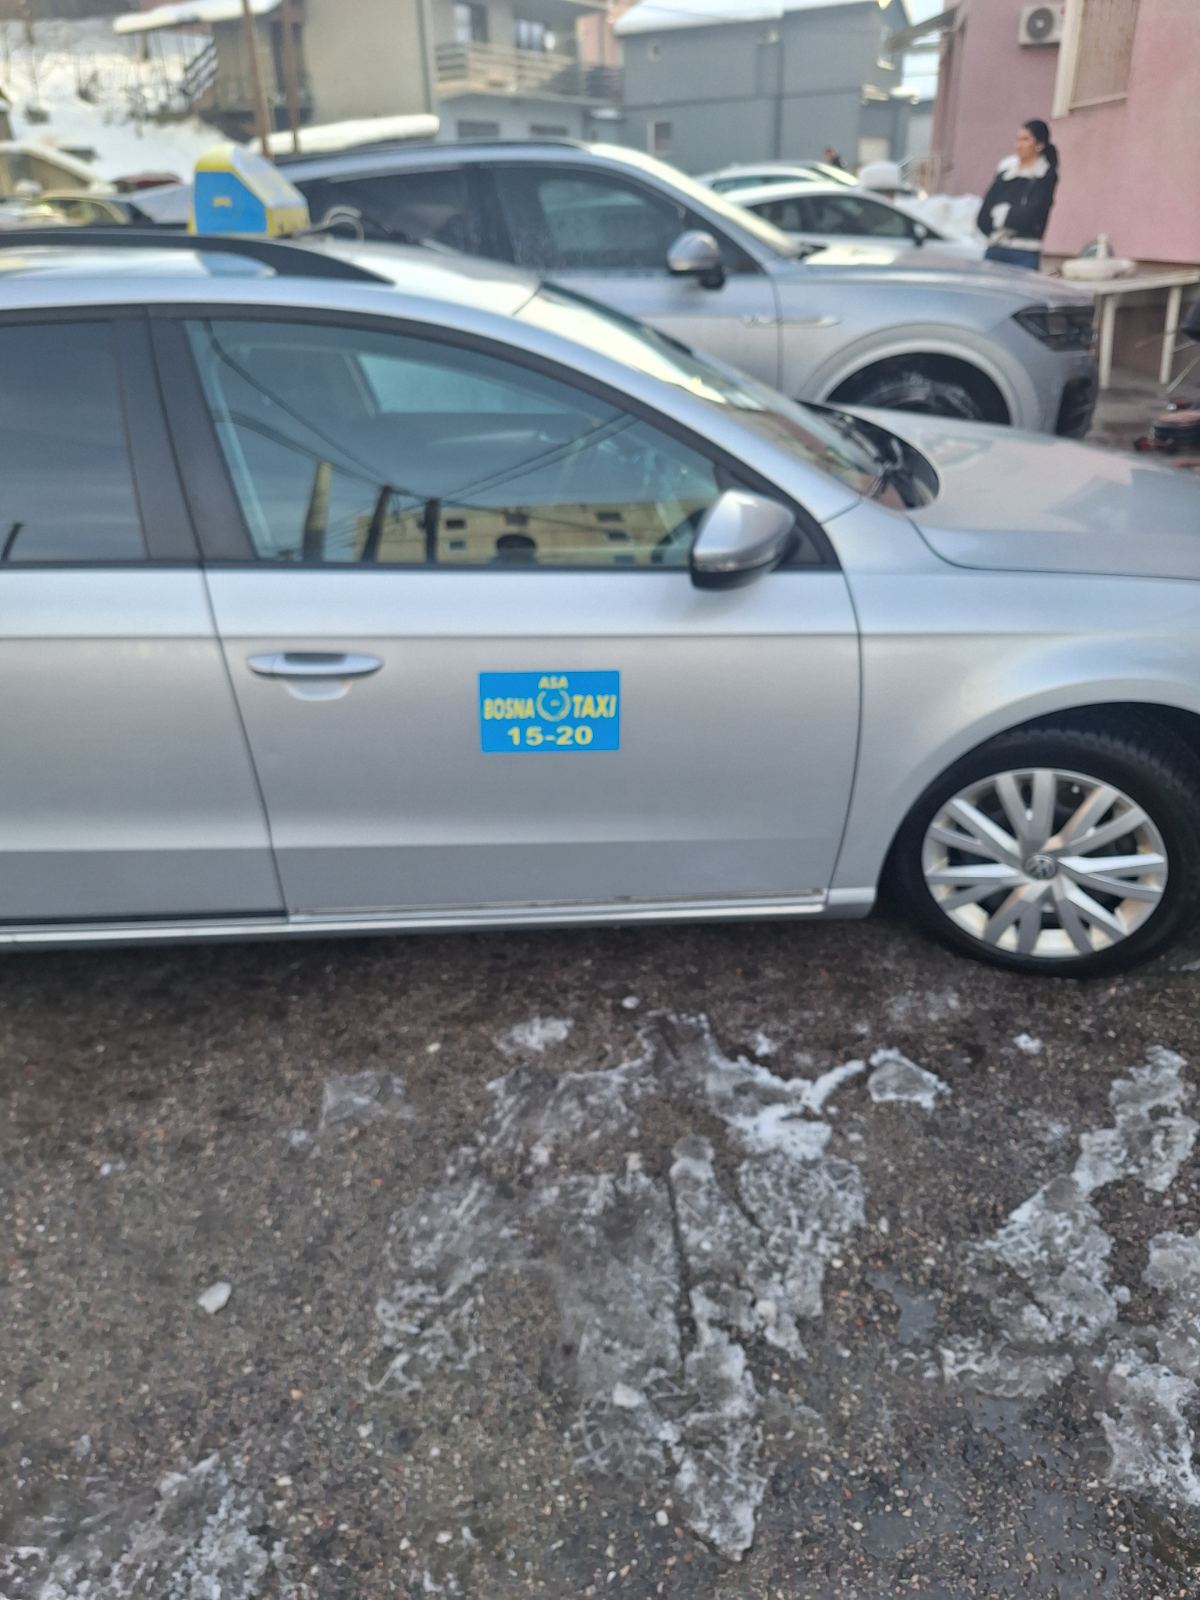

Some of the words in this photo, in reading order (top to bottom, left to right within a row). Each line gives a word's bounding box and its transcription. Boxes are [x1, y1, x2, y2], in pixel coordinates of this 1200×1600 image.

[484, 698, 535, 720] BOSNA
[573, 694, 616, 718] TAXI
[507, 725, 593, 746] 15-20
